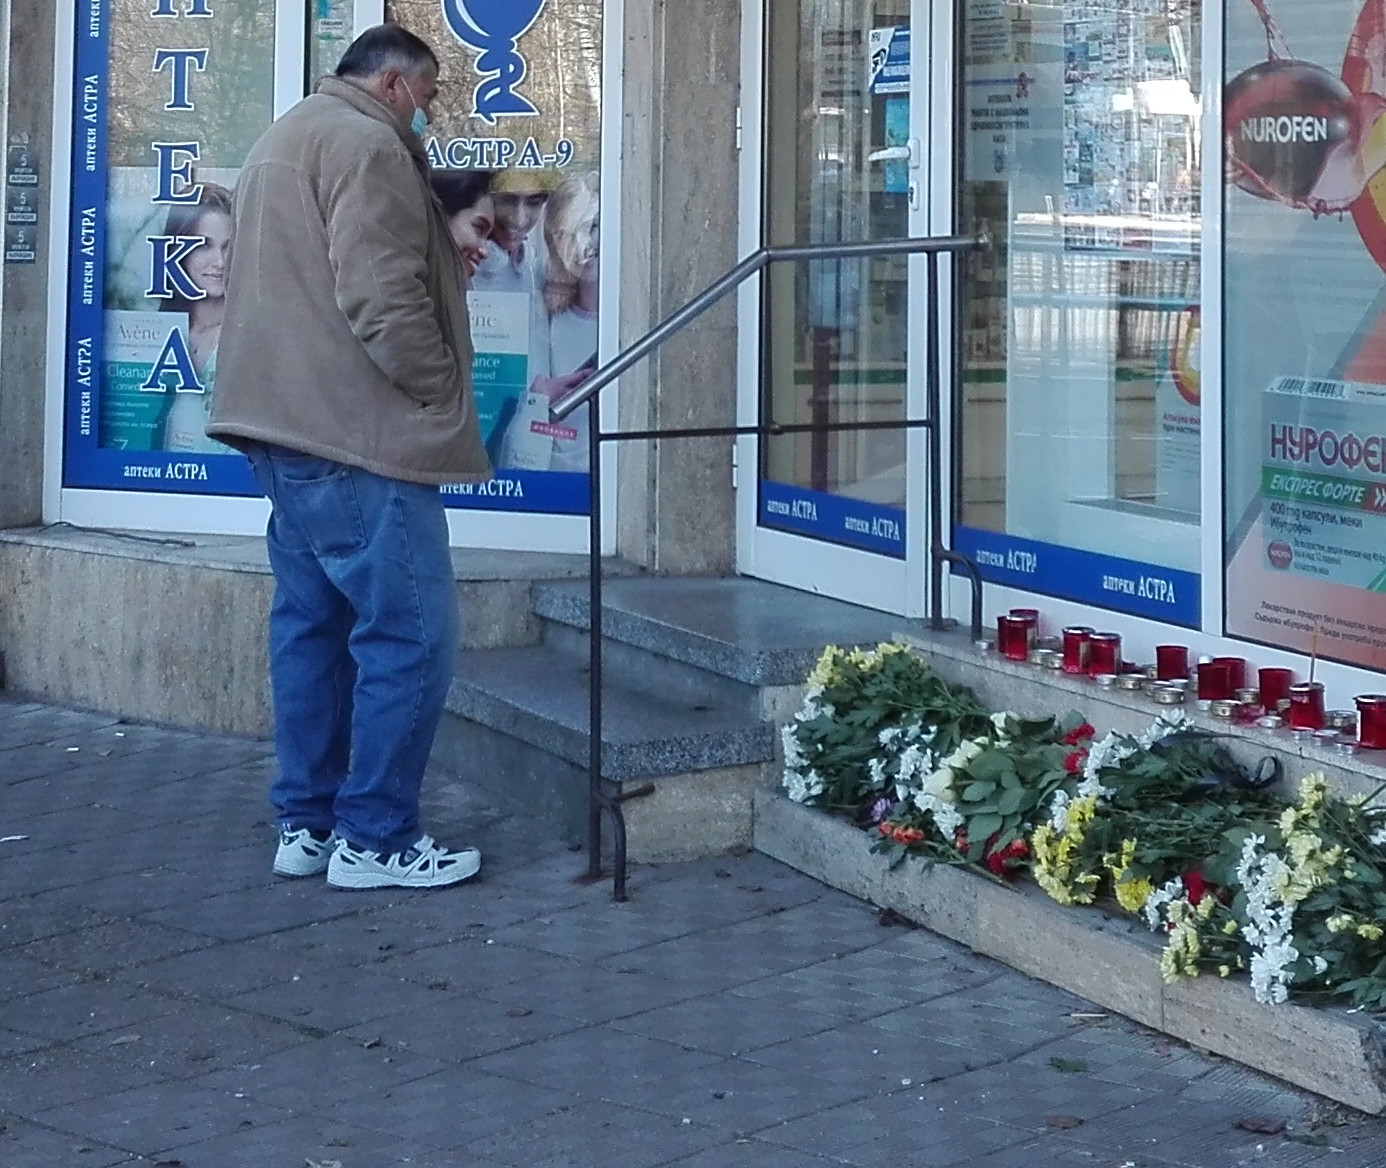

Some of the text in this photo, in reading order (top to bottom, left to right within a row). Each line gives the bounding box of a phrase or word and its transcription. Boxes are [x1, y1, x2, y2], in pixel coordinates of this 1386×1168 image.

[84, 73, 99, 171] аптеки АСТРА
[1241, 116, 1327, 143] NUROFEN
[81, 207, 97, 306] аптеки АСТРА
[77, 336, 92, 436] аптеки АСТРА
[123, 462, 208, 482] аптеки АСТРА
[478, 478, 524, 499] АСТРА
[1270, 473, 1366, 504] ЕКСПРЕС ФОРТЕ
[791, 499, 818, 522] АСТРА
[872, 516, 900, 542] АСТРА
[1103, 573, 1176, 604] аптеки АСТРА
